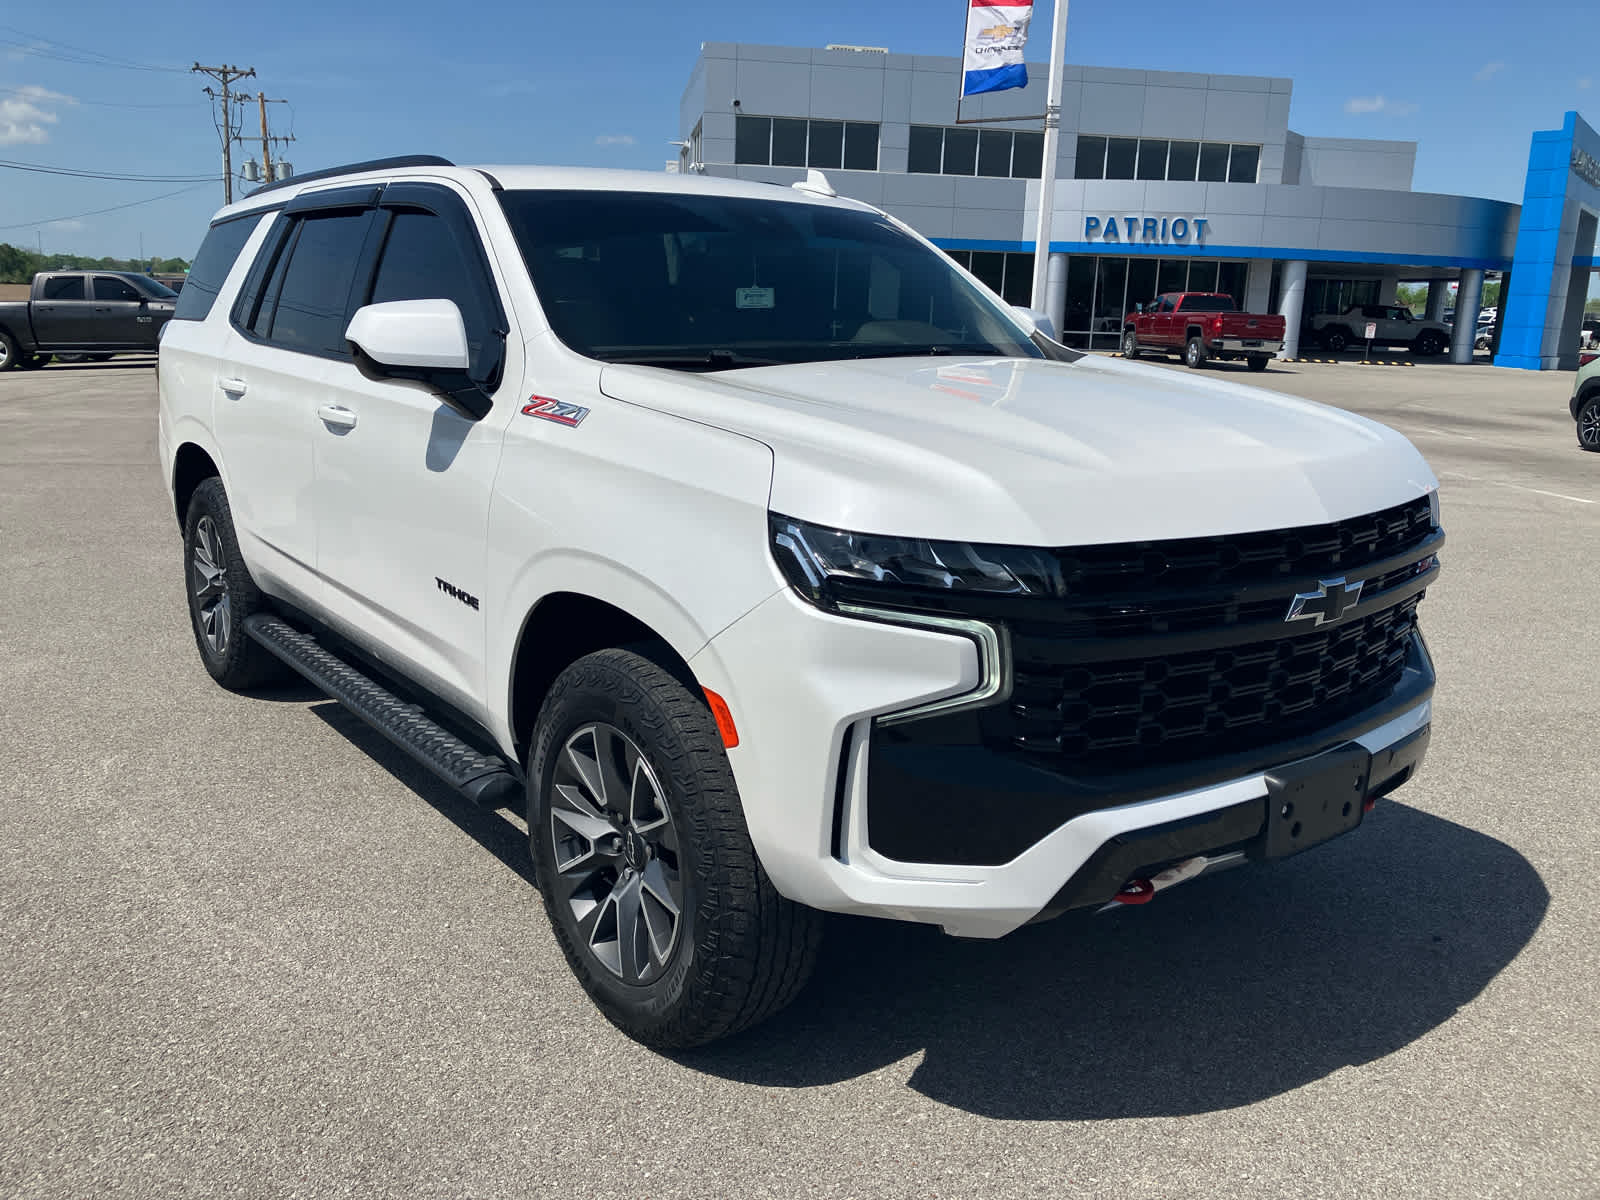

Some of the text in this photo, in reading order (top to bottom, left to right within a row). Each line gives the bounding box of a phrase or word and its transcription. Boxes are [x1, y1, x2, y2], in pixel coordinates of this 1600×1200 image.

[1085, 216, 1208, 240] PATRIOT
[521, 394, 591, 428] Z71
[435, 576, 479, 611] TAHOE
